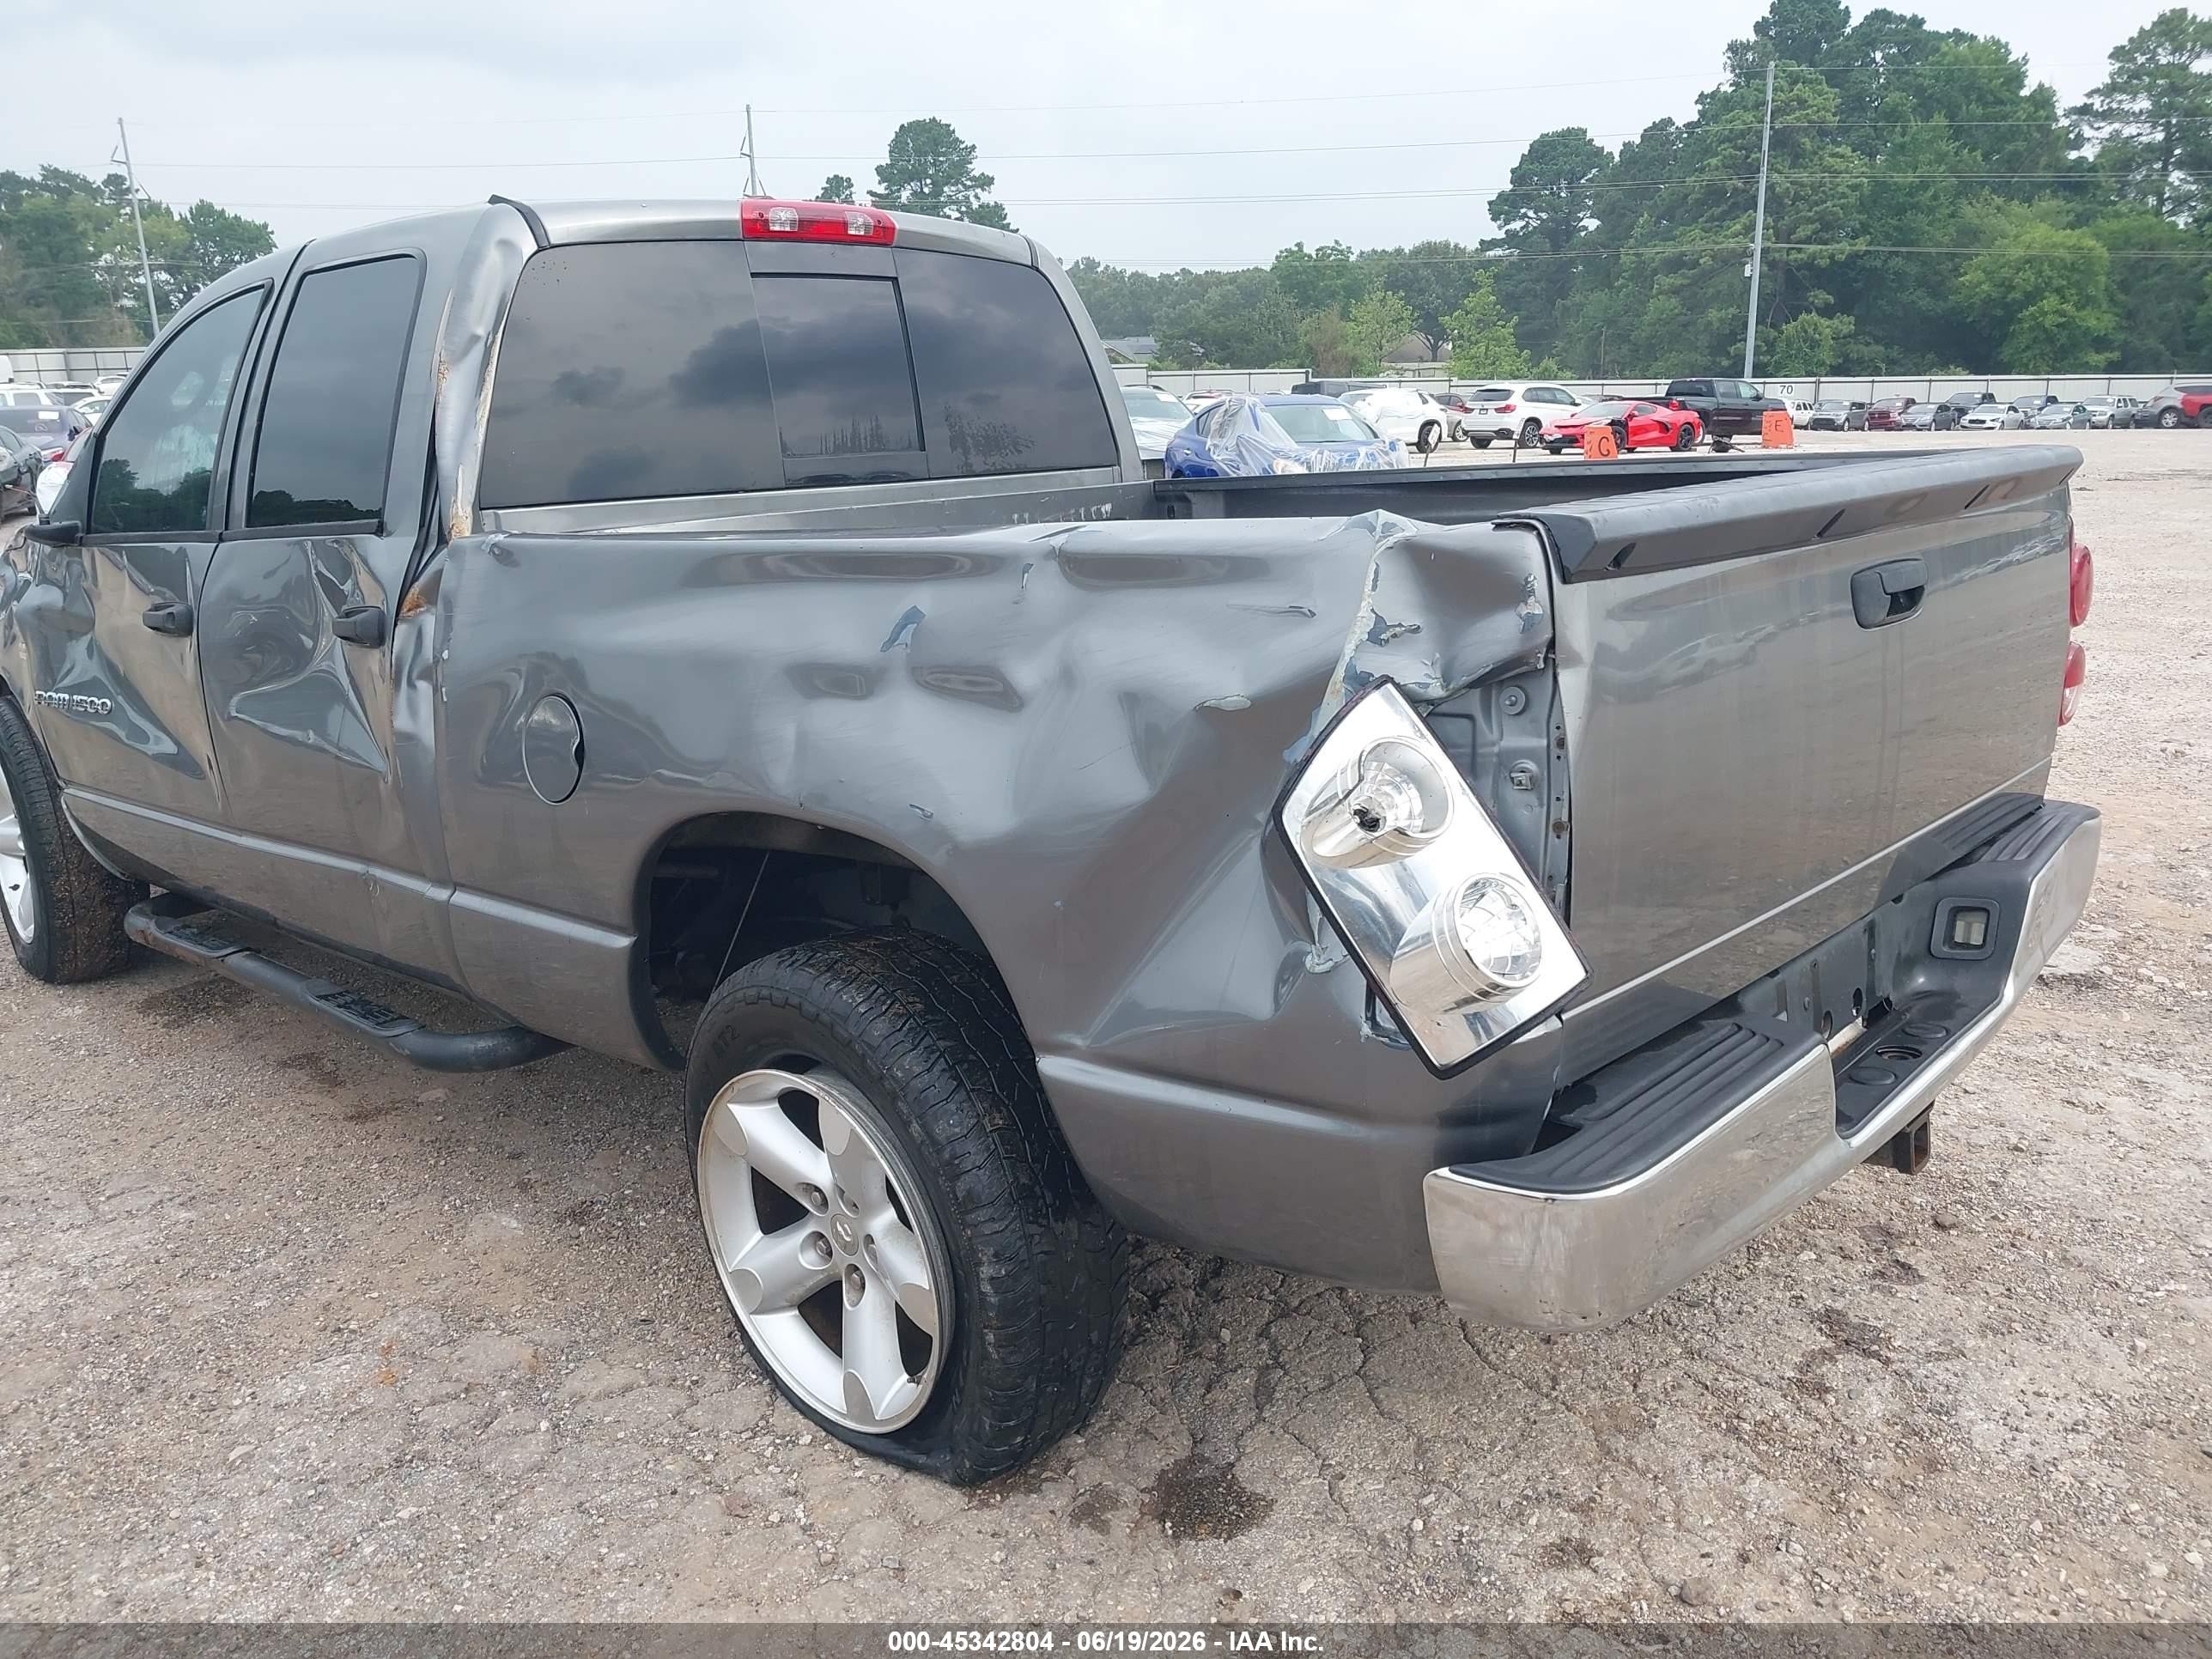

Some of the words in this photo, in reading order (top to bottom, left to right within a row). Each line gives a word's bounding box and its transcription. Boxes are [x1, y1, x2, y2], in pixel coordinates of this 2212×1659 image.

[1779, 385, 1793, 395] 70
[1775, 419, 1784, 433] E
[72, 695, 112, 714] 1500
